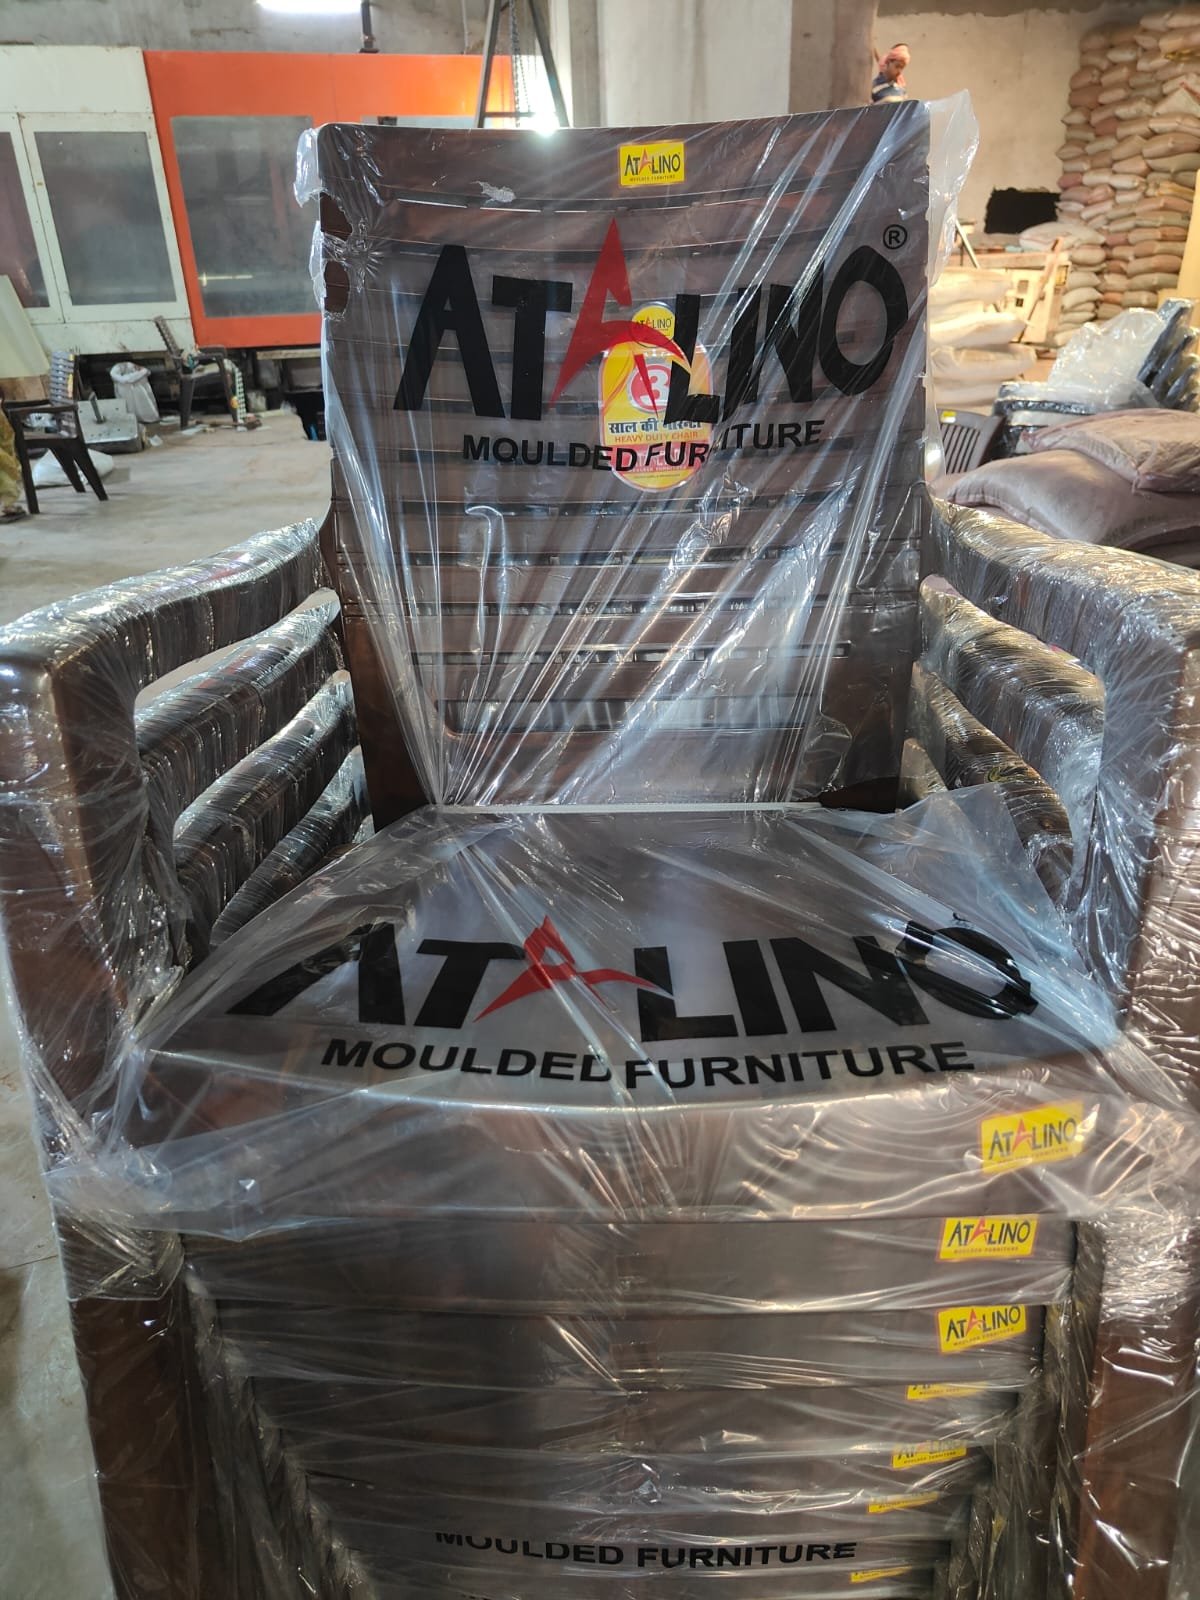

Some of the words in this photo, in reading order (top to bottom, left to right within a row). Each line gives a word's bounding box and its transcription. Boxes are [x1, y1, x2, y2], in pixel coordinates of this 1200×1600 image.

[624, 147, 681, 176] ATALINO
[393, 218, 909, 424] ATALINO
[640, 369, 669, 406] 3
[608, 422, 638, 434] साल
[640, 417, 658, 432] की
[615, 434, 645, 443] HEAVY
[646, 432, 669, 442] DUTY
[672, 431, 698, 440] CHAIR
[463, 434, 637, 472] MOULDED
[646, 420, 825, 467] FURITURE
[226, 915, 1038, 1042] ATALINO
[321, 1038, 611, 1083] MOULDED
[625, 1041, 975, 1089] FURNITURE
[988, 1118, 1077, 1160] ATALINO
[947, 1217, 1031, 1247] ATALINO
[946, 1306, 1021, 1342] ATALINO
[435, 1532, 624, 1565] MOULDED
[637, 1542, 858, 1569] FURNITURE
